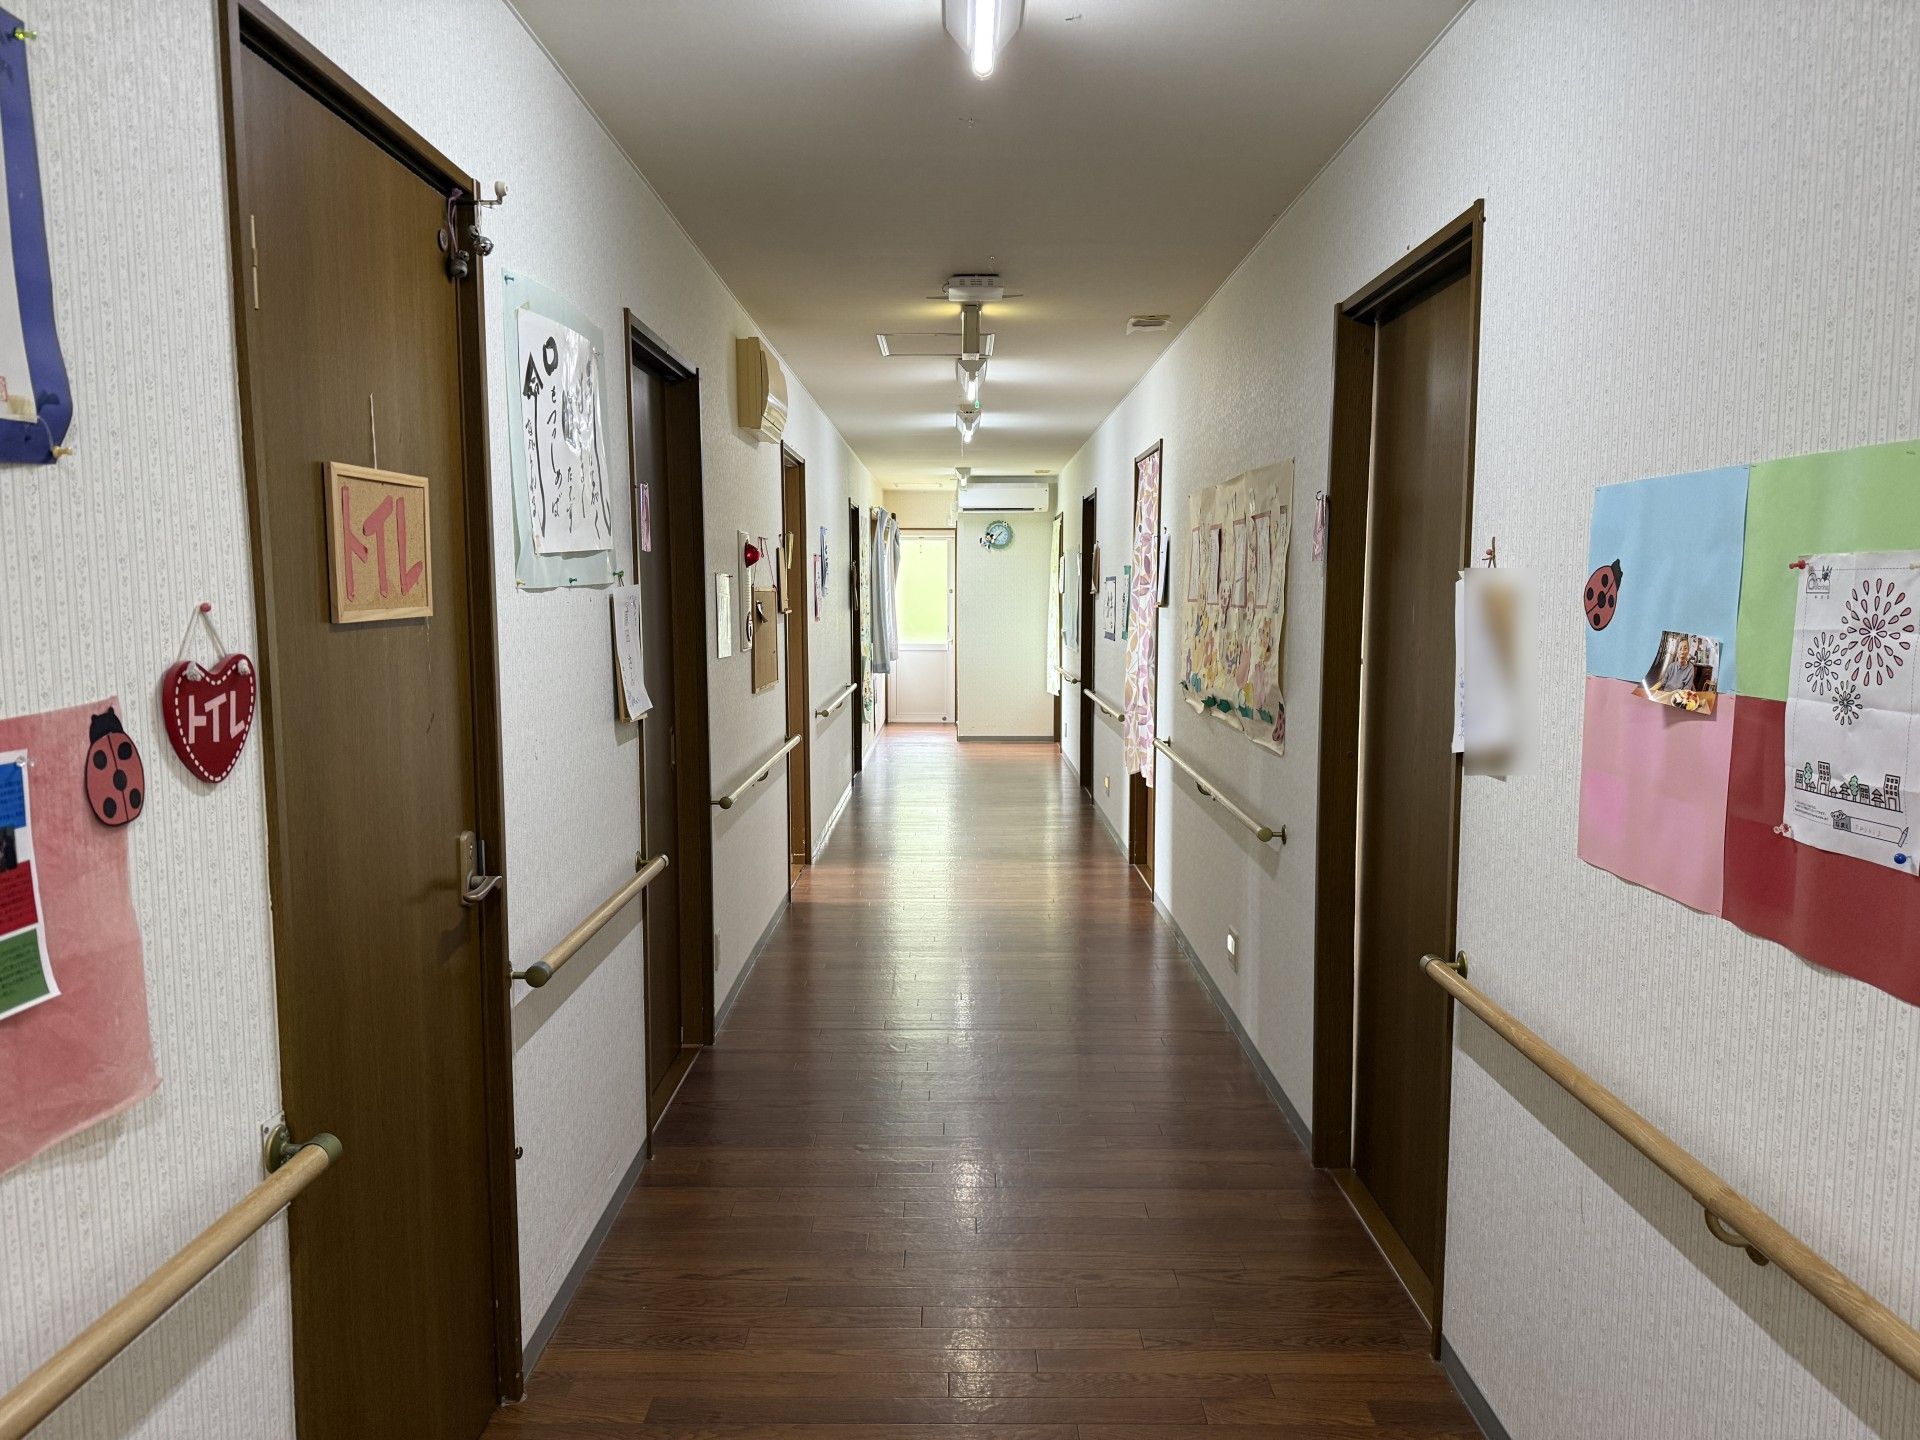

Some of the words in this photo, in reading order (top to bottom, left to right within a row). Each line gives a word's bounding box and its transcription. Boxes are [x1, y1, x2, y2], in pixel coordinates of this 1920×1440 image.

[341, 484, 424, 602] トイレ
[188, 690, 246, 745] トイレ
